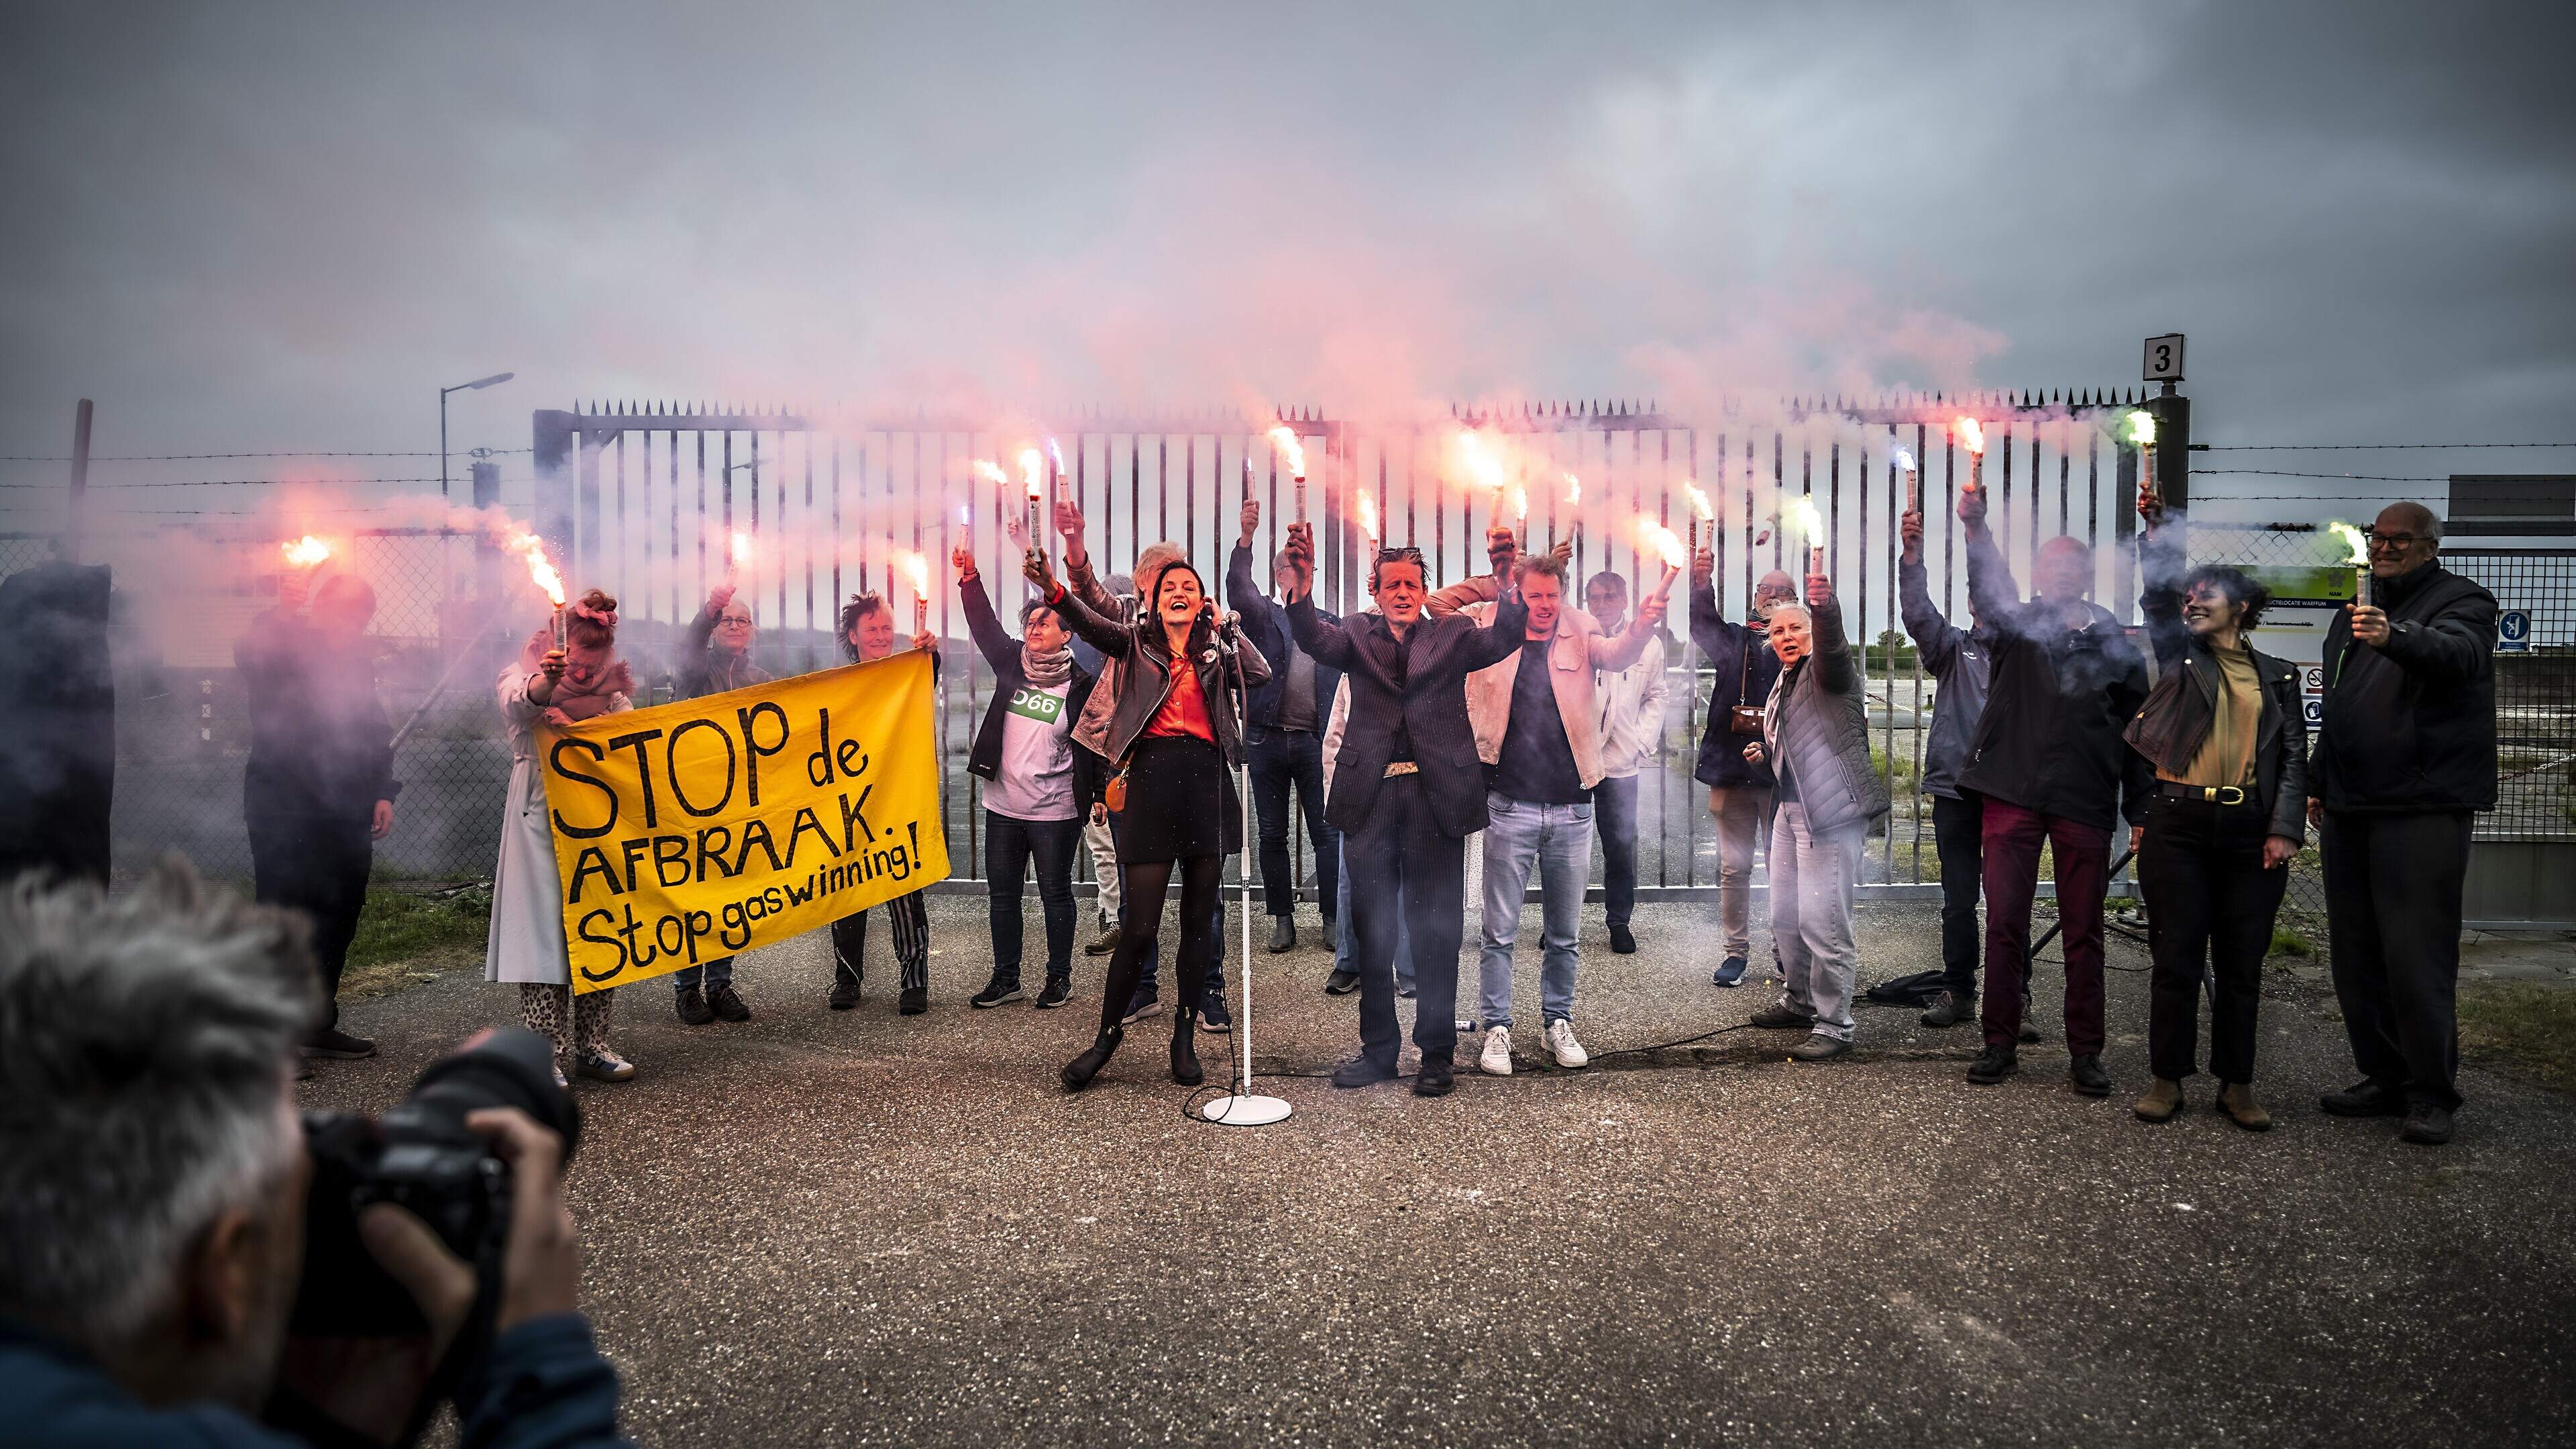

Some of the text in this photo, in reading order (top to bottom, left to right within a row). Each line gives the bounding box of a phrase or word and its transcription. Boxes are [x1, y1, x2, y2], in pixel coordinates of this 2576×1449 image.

[2155, 344, 2171, 372] 3
[1009, 690, 1057, 713] D66
[549, 702, 869, 839] STOP de
[568, 784, 894, 904] AFBRAAK.
[578, 821, 922, 982] Stop gaswinning!
